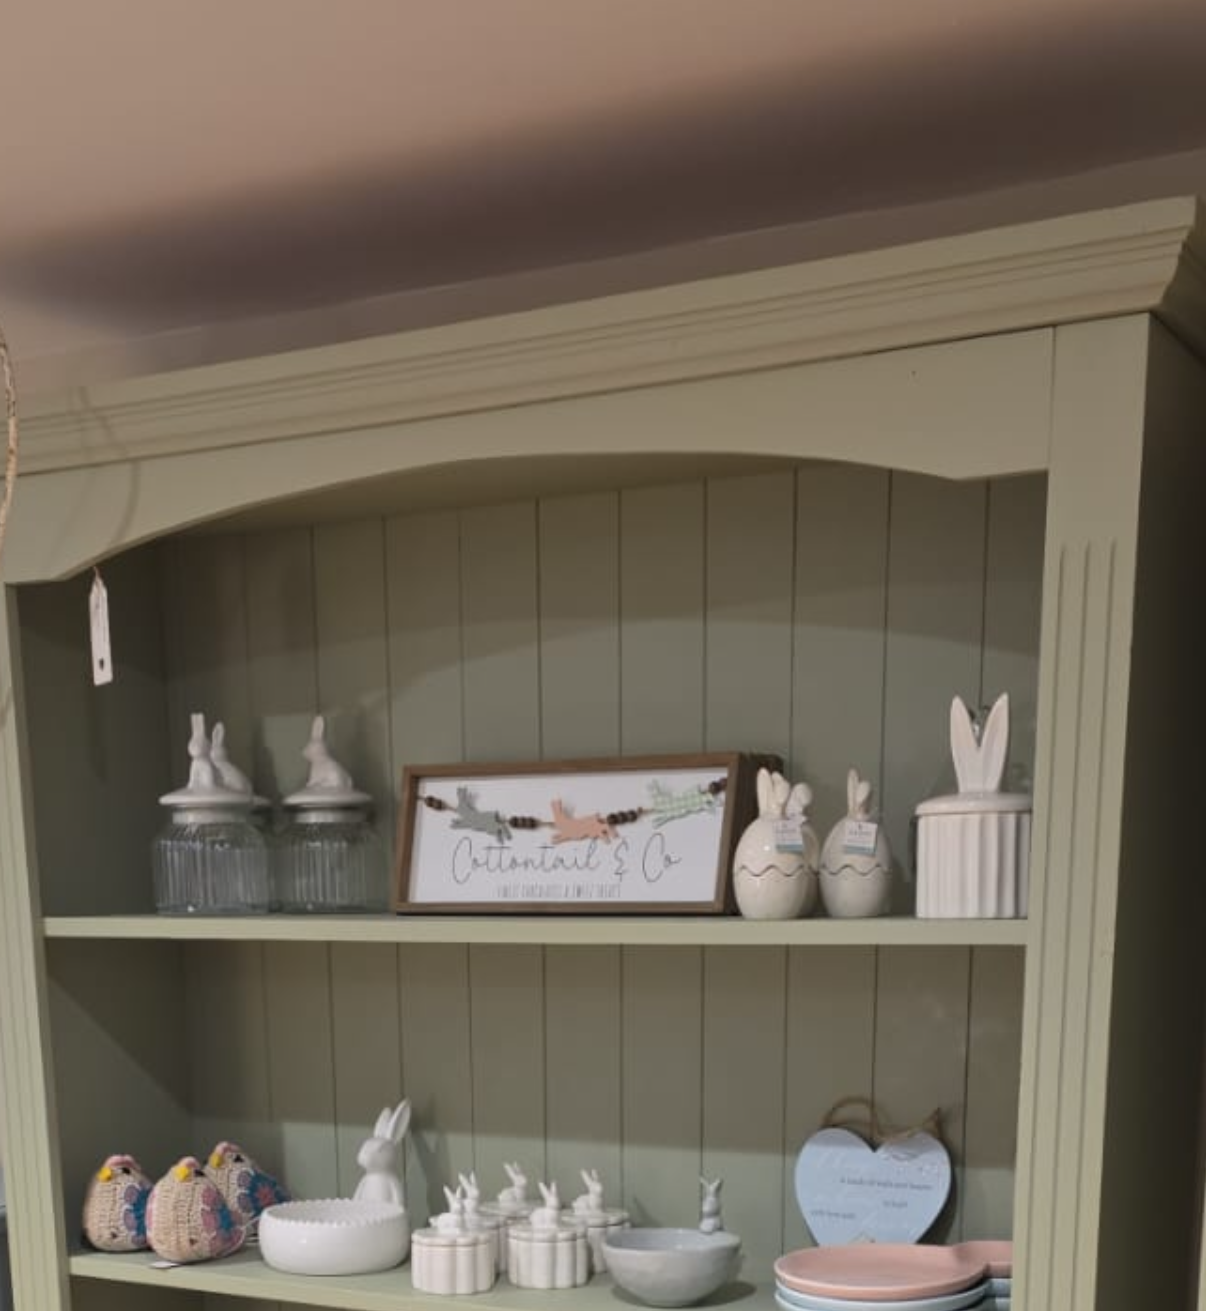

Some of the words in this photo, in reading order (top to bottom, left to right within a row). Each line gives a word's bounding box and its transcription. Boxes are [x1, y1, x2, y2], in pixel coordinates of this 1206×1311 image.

[452, 836, 601, 885] Cottontail
[613, 838, 630, 883] &
[642, 832, 682, 883] Co
